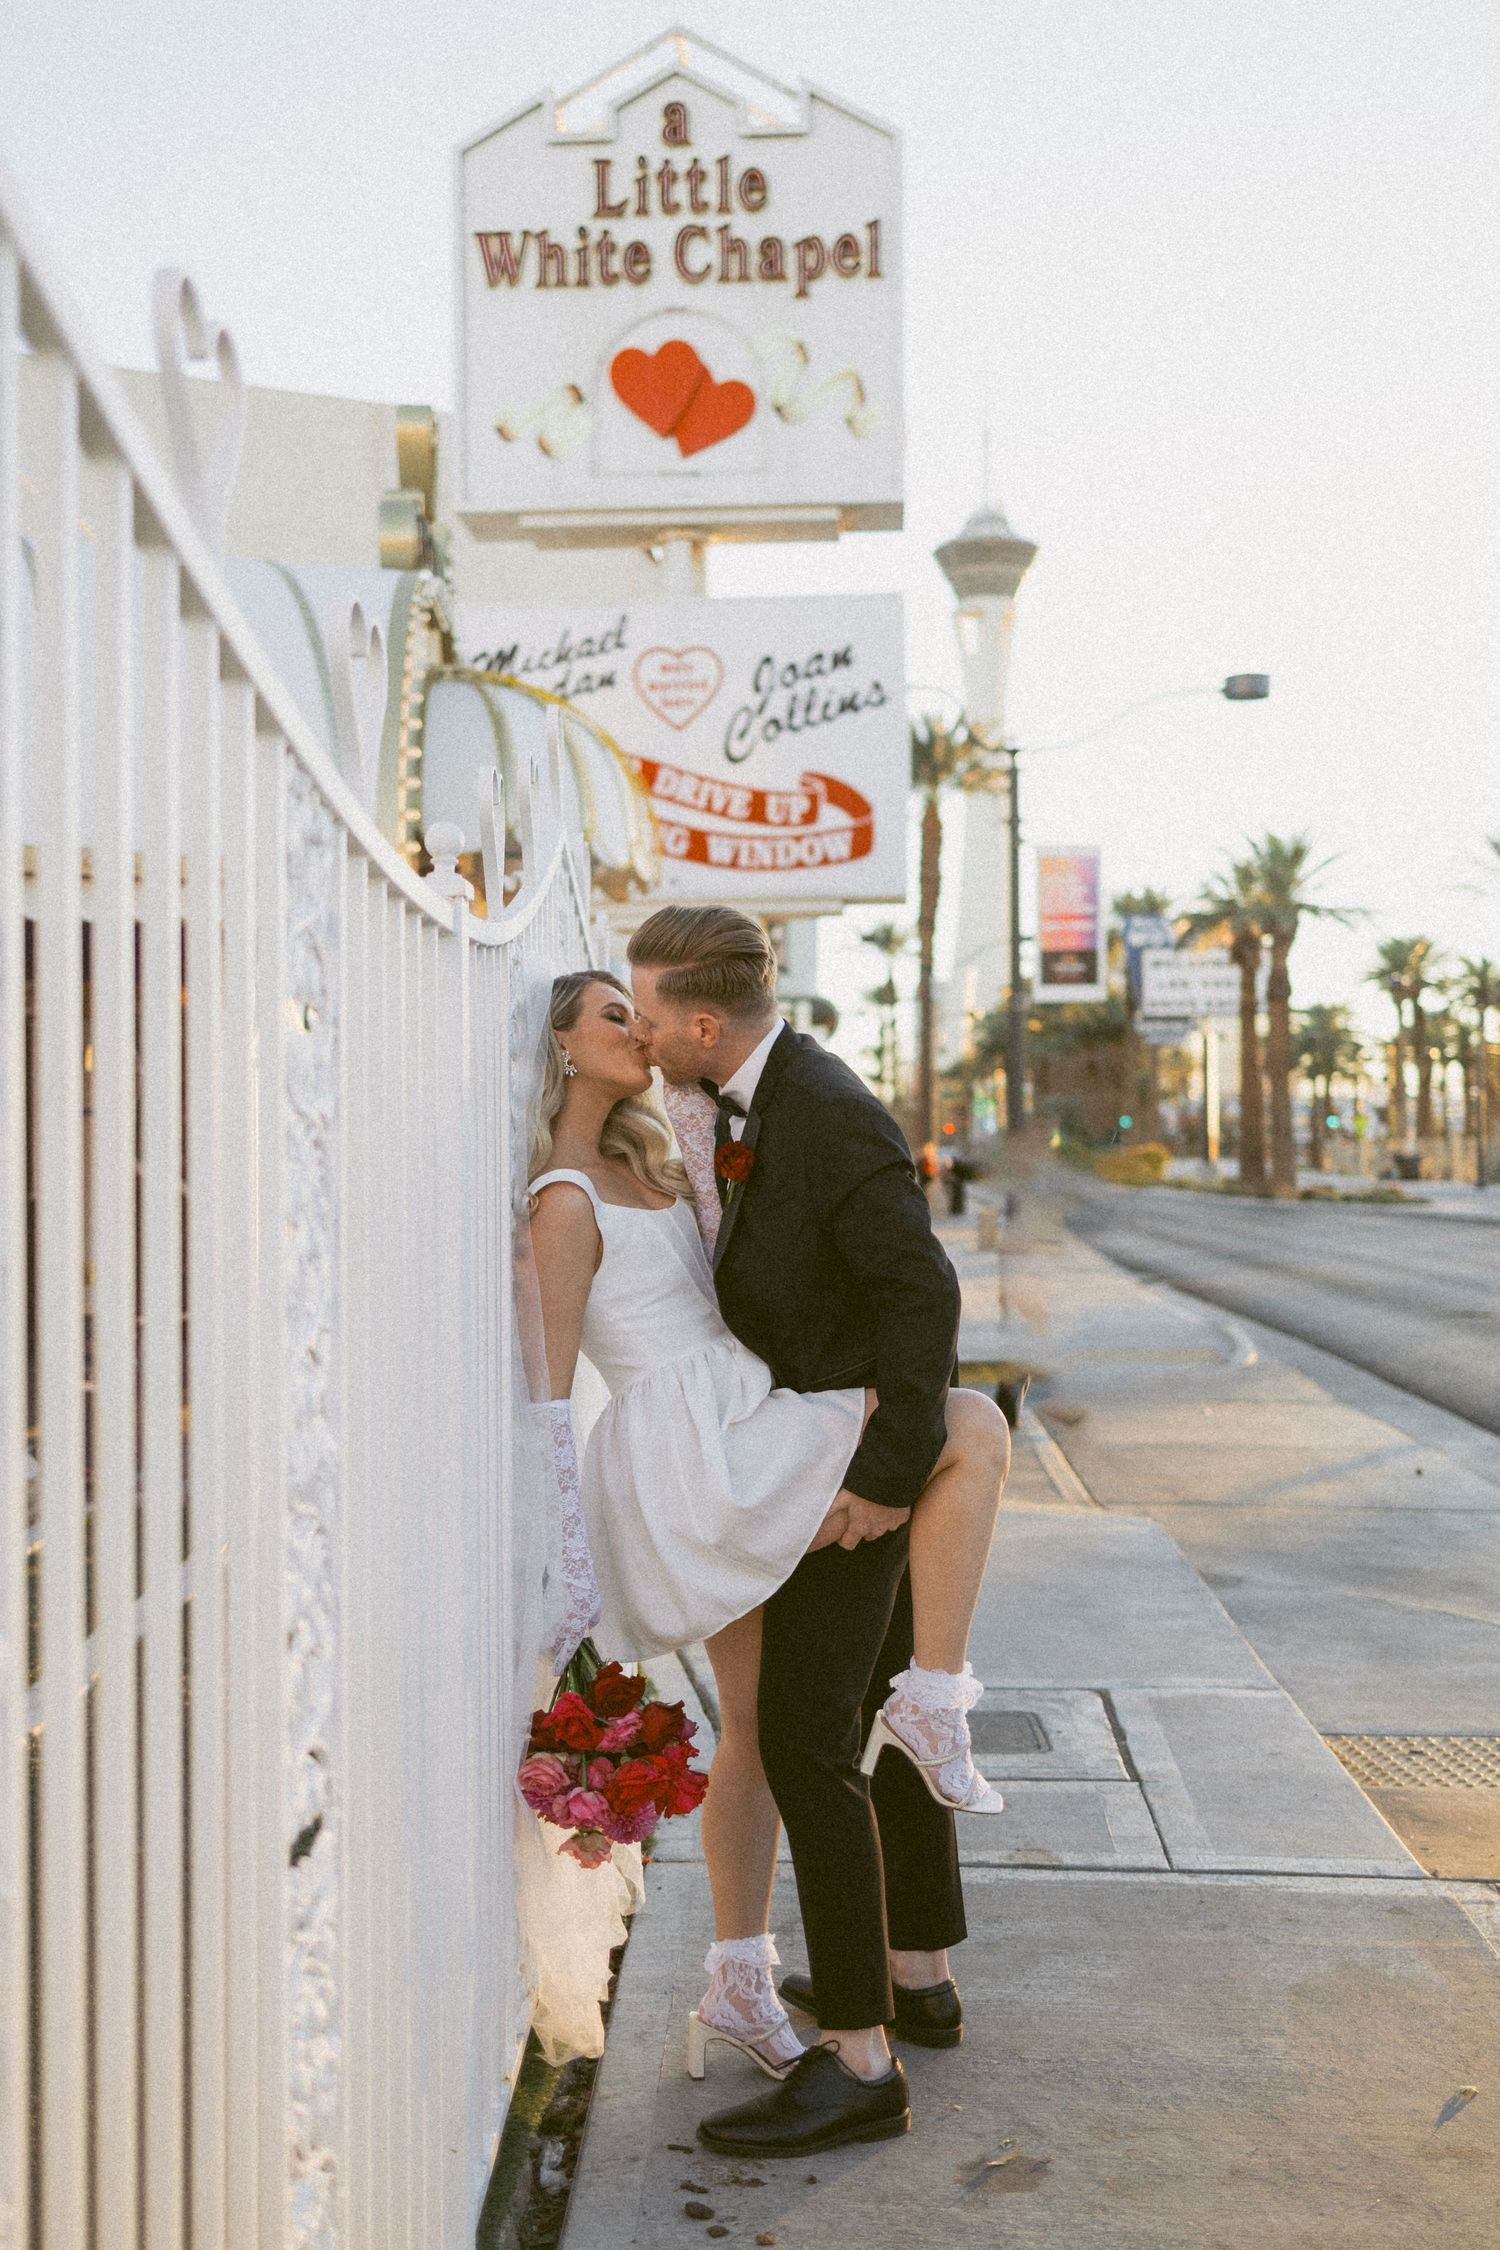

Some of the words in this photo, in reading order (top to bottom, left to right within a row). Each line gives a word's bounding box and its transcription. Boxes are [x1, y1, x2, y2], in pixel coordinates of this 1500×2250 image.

[662, 101, 690, 146] a
[593, 155, 768, 218] Little
[475, 225, 652, 288] White
[675, 219, 881, 298] Chapel
[753, 643, 853, 716] Joan
[724, 680, 887, 764] Collins
[652, 763, 753, 823] DRIVE
[765, 792, 812, 825] UP
[706, 828, 854, 870] WINDOW
